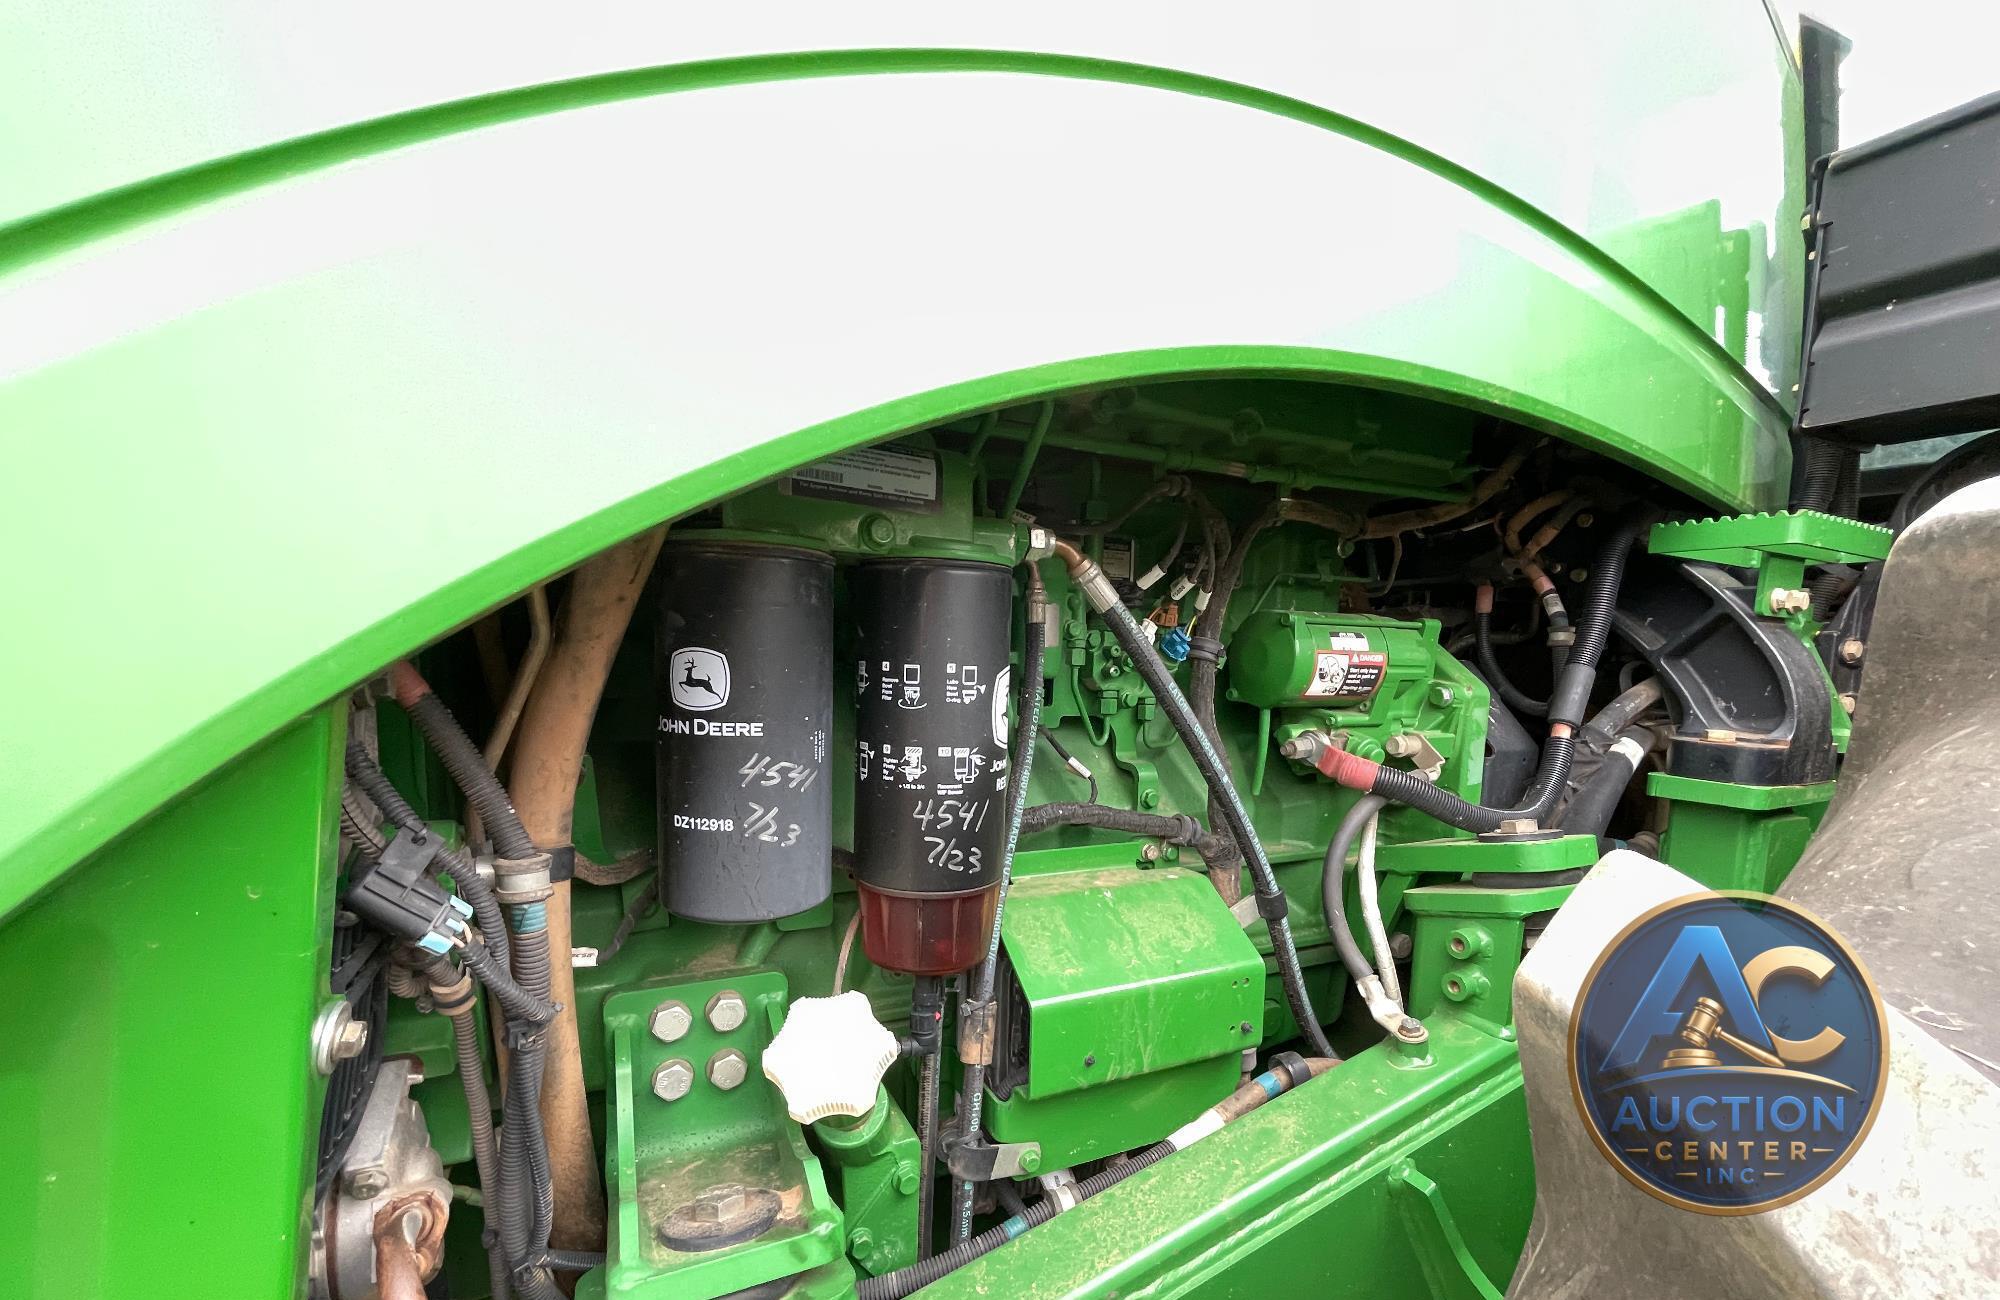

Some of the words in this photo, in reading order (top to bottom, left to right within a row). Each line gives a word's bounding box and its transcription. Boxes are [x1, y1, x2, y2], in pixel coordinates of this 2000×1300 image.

[1031, 686, 1043, 723] RATED
[1166, 681, 1190, 712] EATON
[658, 715, 690, 734] JOHN
[693, 718, 764, 737] DEERE
[1024, 739, 1036, 763] BAR
[738, 753, 818, 793] 4541
[674, 815, 734, 831] DZ112918
[913, 798, 990, 833] 4541
[1007, 816, 1021, 851] MADE
[924, 836, 982, 874] 7/23
